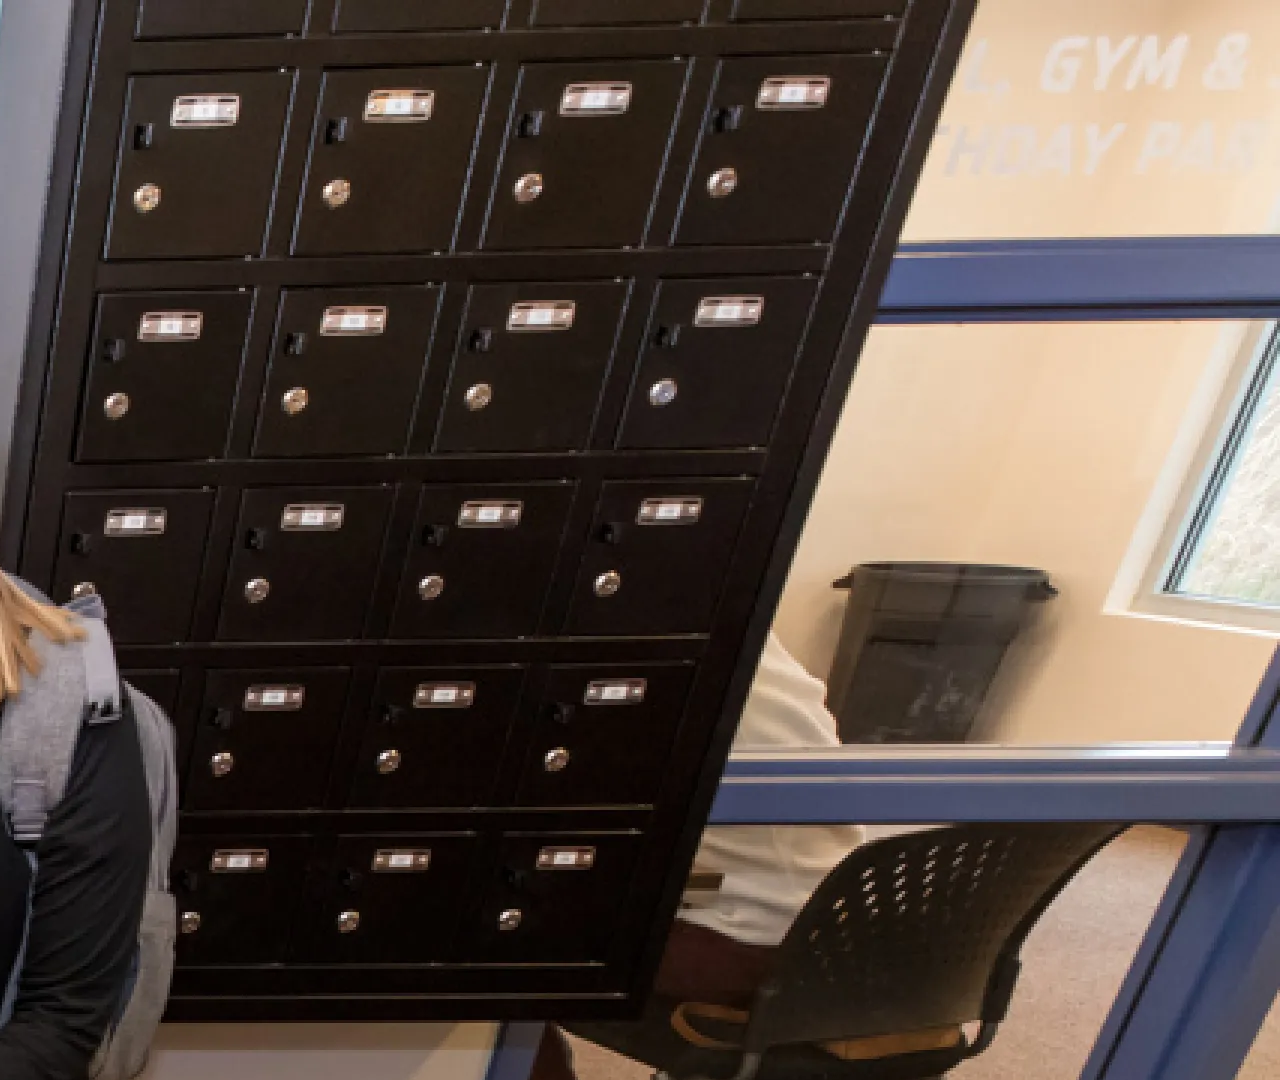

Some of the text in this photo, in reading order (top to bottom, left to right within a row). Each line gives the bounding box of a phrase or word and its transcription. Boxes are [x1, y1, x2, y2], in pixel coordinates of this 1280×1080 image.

[1042, 35, 1189, 90] GYM
[1203, 32, 1250, 90] &
[938, 122, 1126, 177] HDAY
